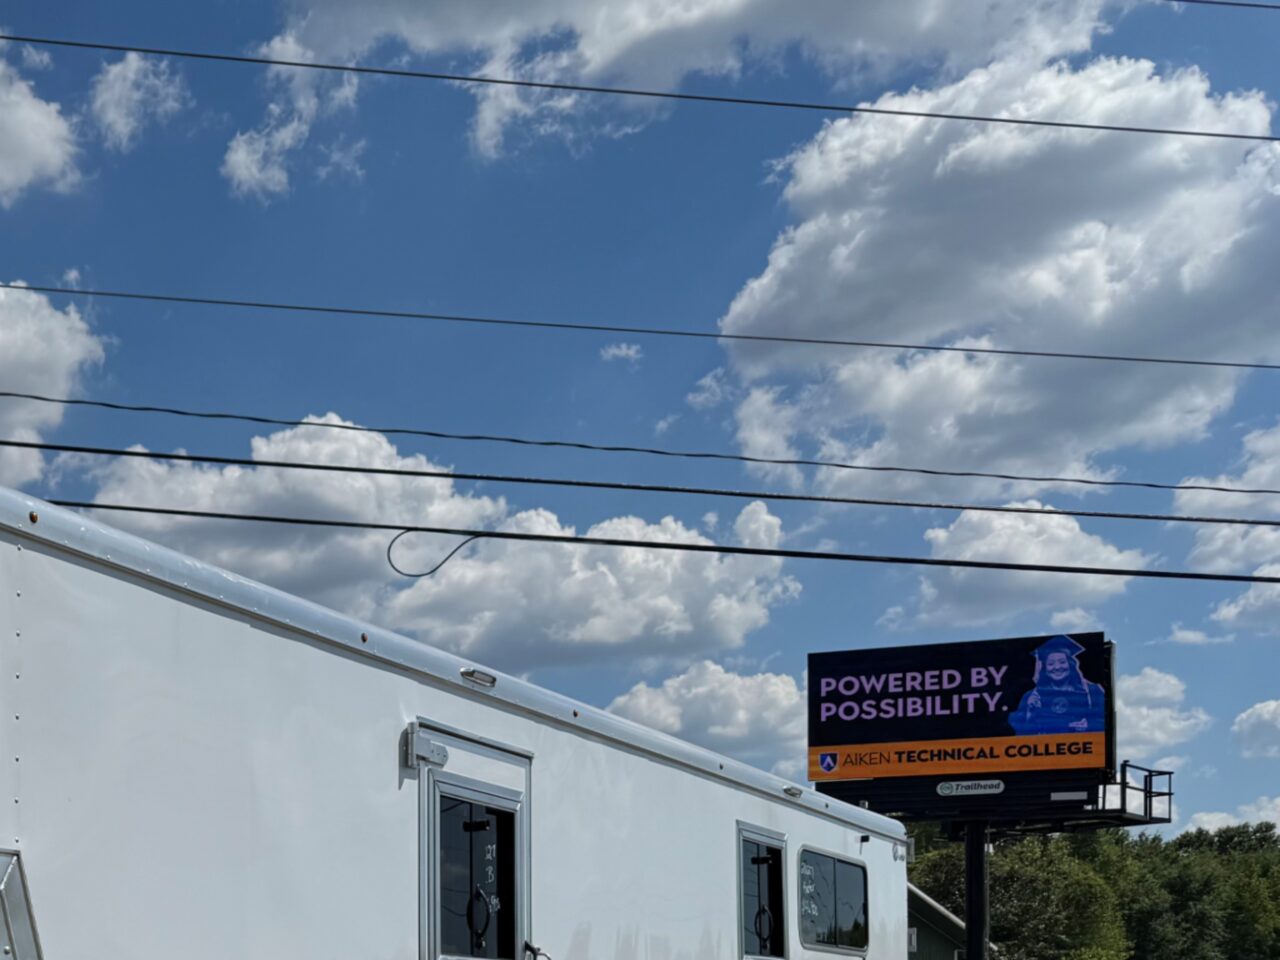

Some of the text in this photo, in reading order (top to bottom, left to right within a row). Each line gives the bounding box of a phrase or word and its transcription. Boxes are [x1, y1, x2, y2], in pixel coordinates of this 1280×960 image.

[820, 665, 1008, 697] POWERED BY
[820, 691, 1008, 722] POSSIBILITY.
[842, 741, 1093, 767] AIKEN TECHNICAL COLLEGE
[954, 781, 1001, 791] Trailhead
